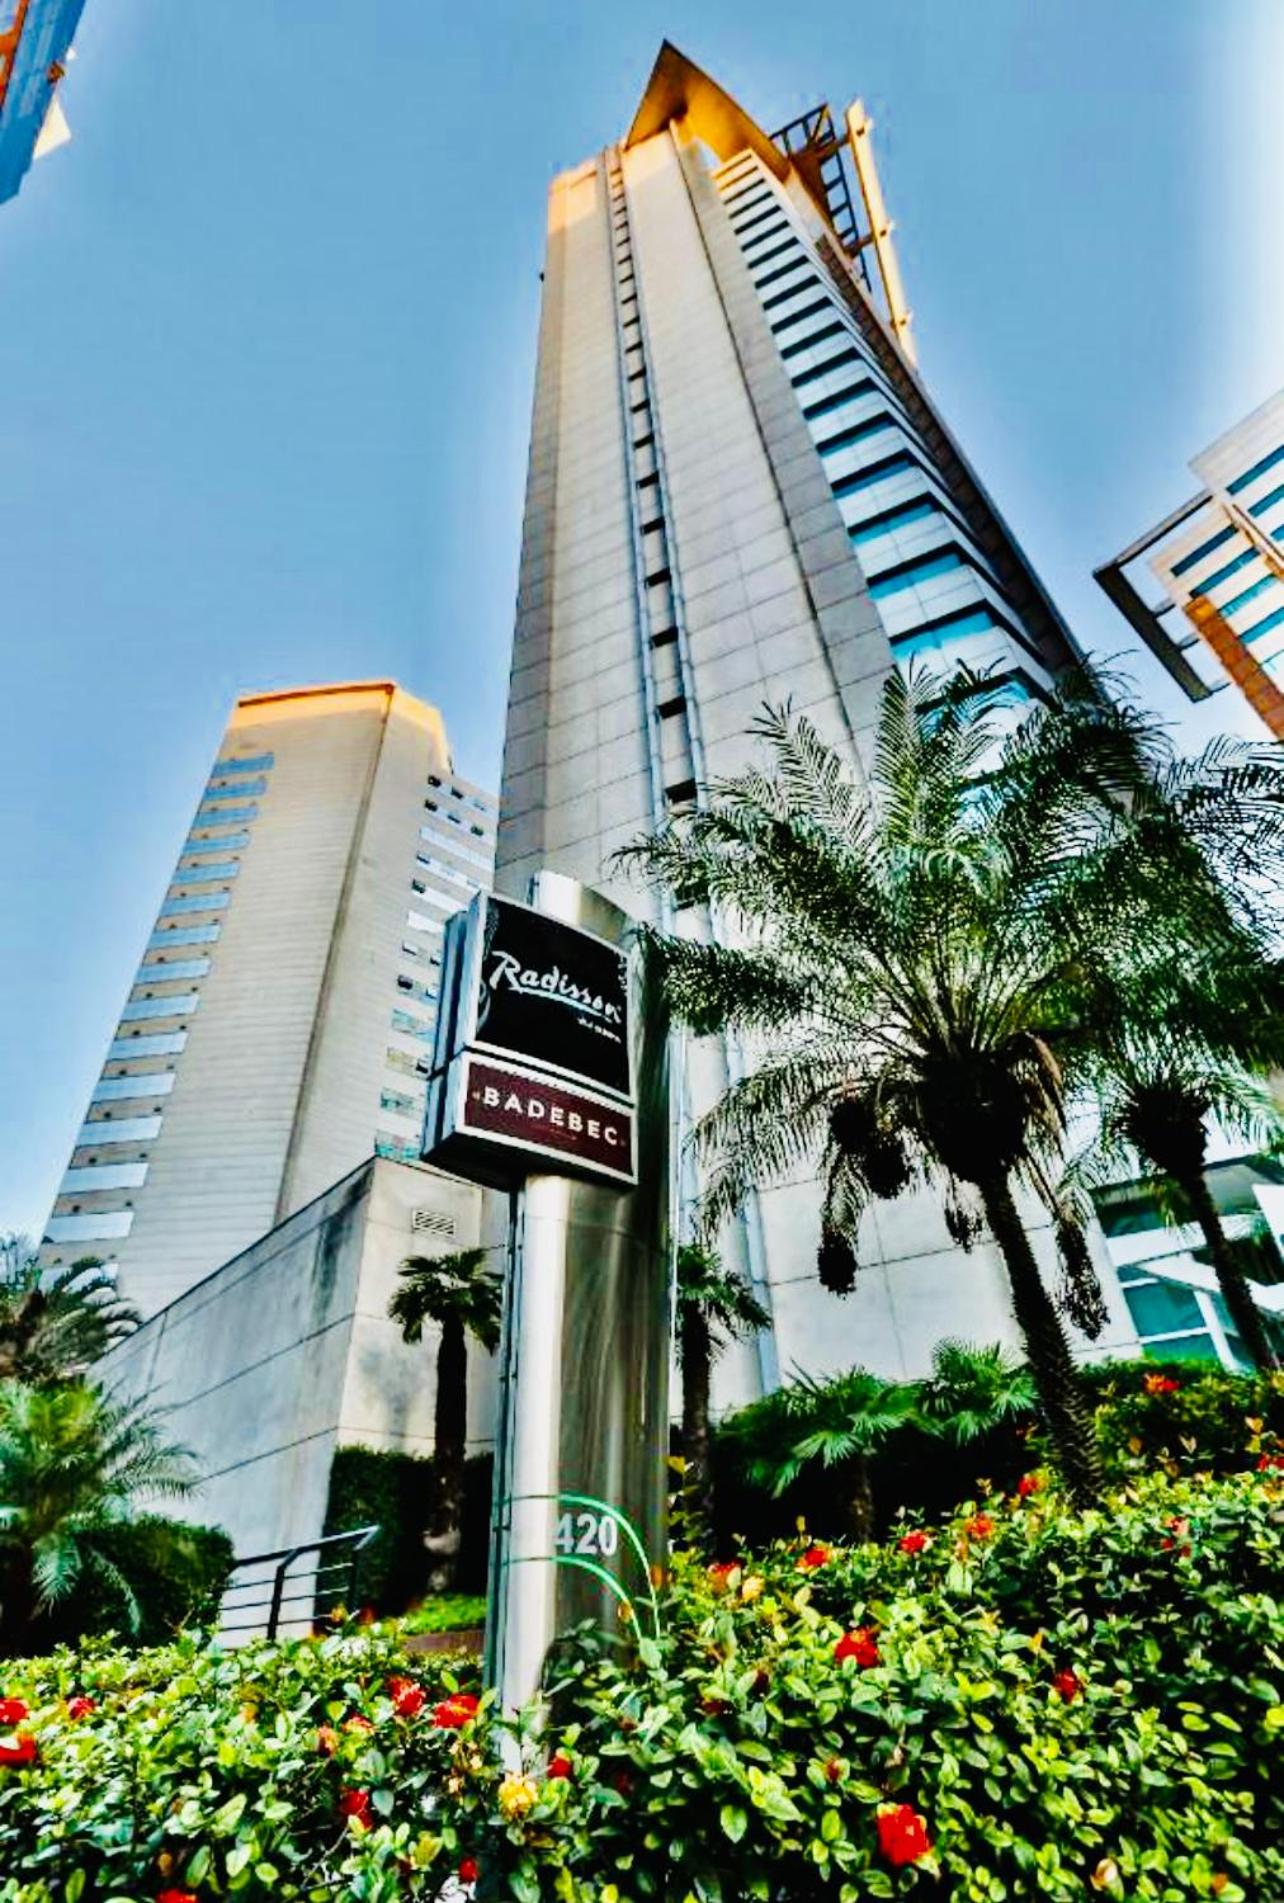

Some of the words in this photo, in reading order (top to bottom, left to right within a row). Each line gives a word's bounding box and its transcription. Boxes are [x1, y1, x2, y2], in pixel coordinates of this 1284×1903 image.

[489, 950, 622, 1024] Radisson
[483, 1085, 618, 1145] BADEBEC
[554, 1512, 618, 1557] 420
